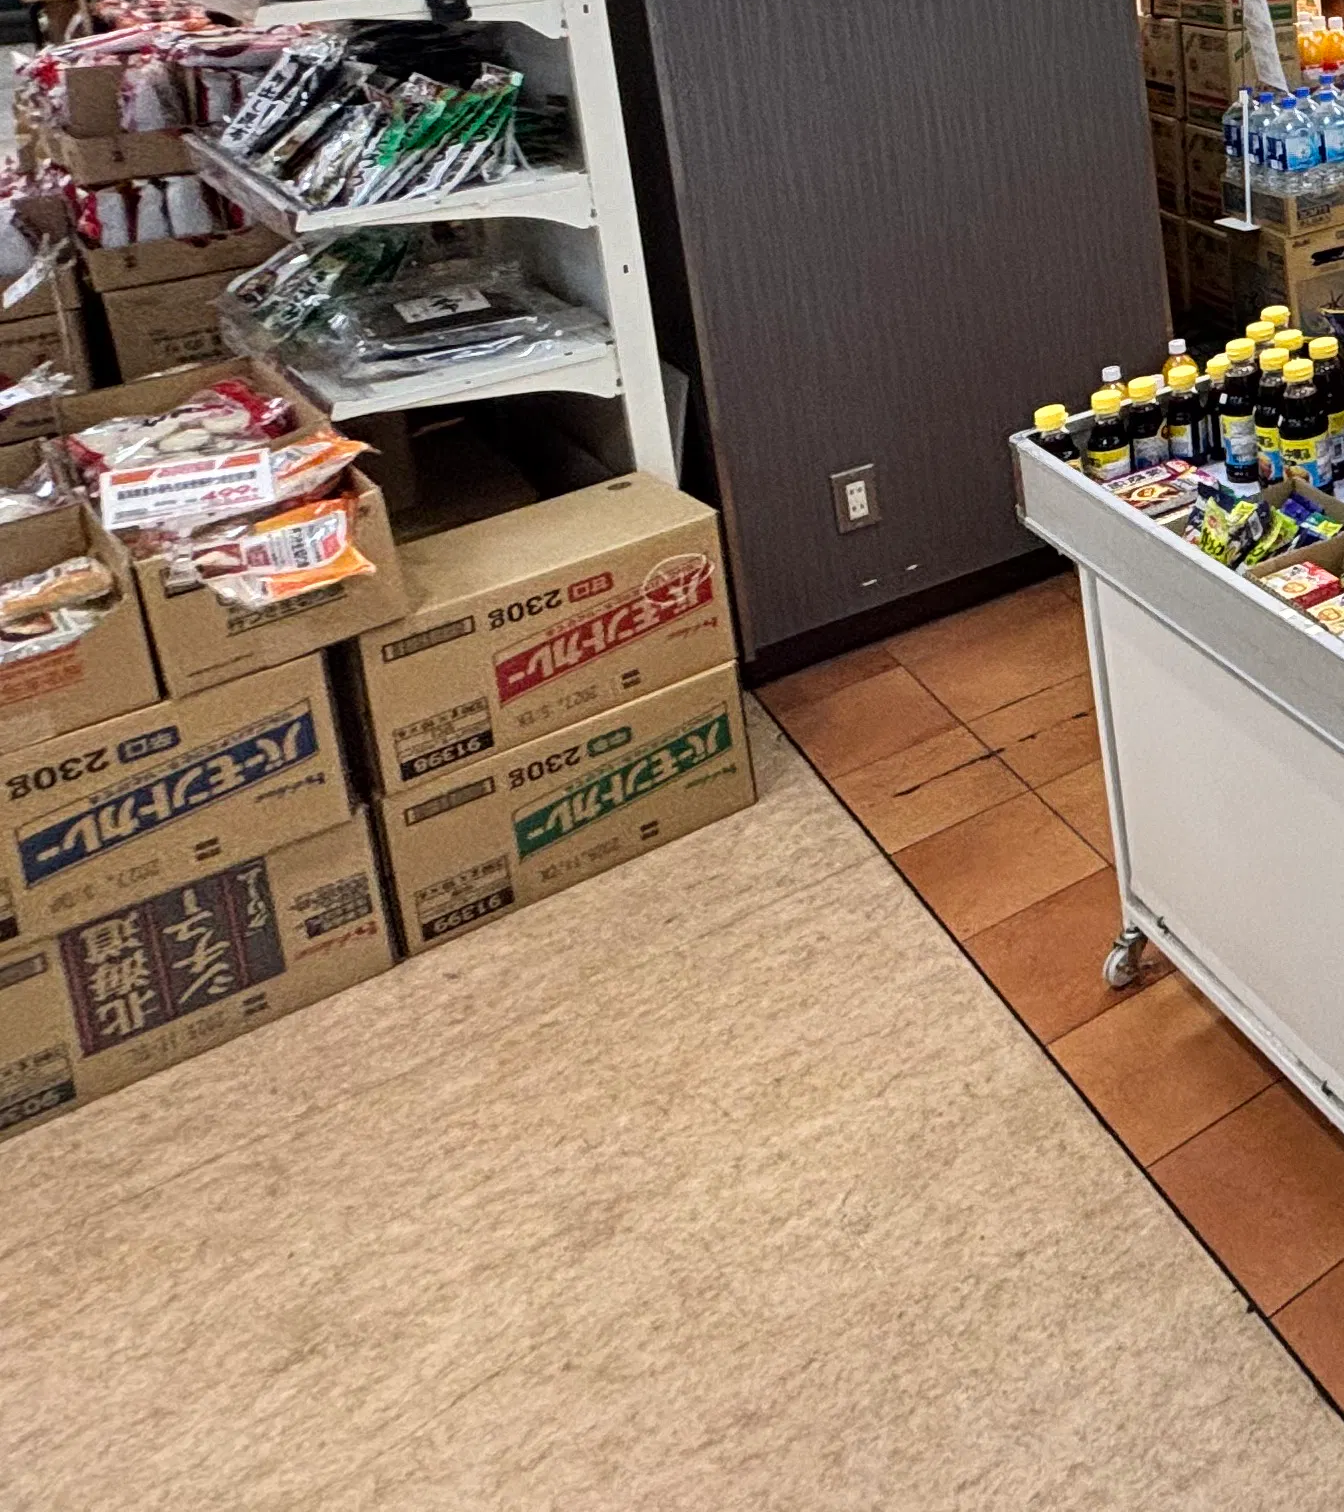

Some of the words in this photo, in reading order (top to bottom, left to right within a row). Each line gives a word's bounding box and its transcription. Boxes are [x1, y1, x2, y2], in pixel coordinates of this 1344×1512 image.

[487, 588, 563, 630] 230g
[508, 570, 709, 685] バーモントカレー
[6, 746, 110, 802] 230g
[36, 720, 302, 863] バーモントカレー
[412, 737, 482, 773] 91398
[508, 746, 580, 789] 230g
[526, 720, 721, 841] バーモントカレー
[161, 887, 232, 1005] シチュー
[432, 895, 502, 933] 91399
[79, 911, 156, 1038] 北海道
